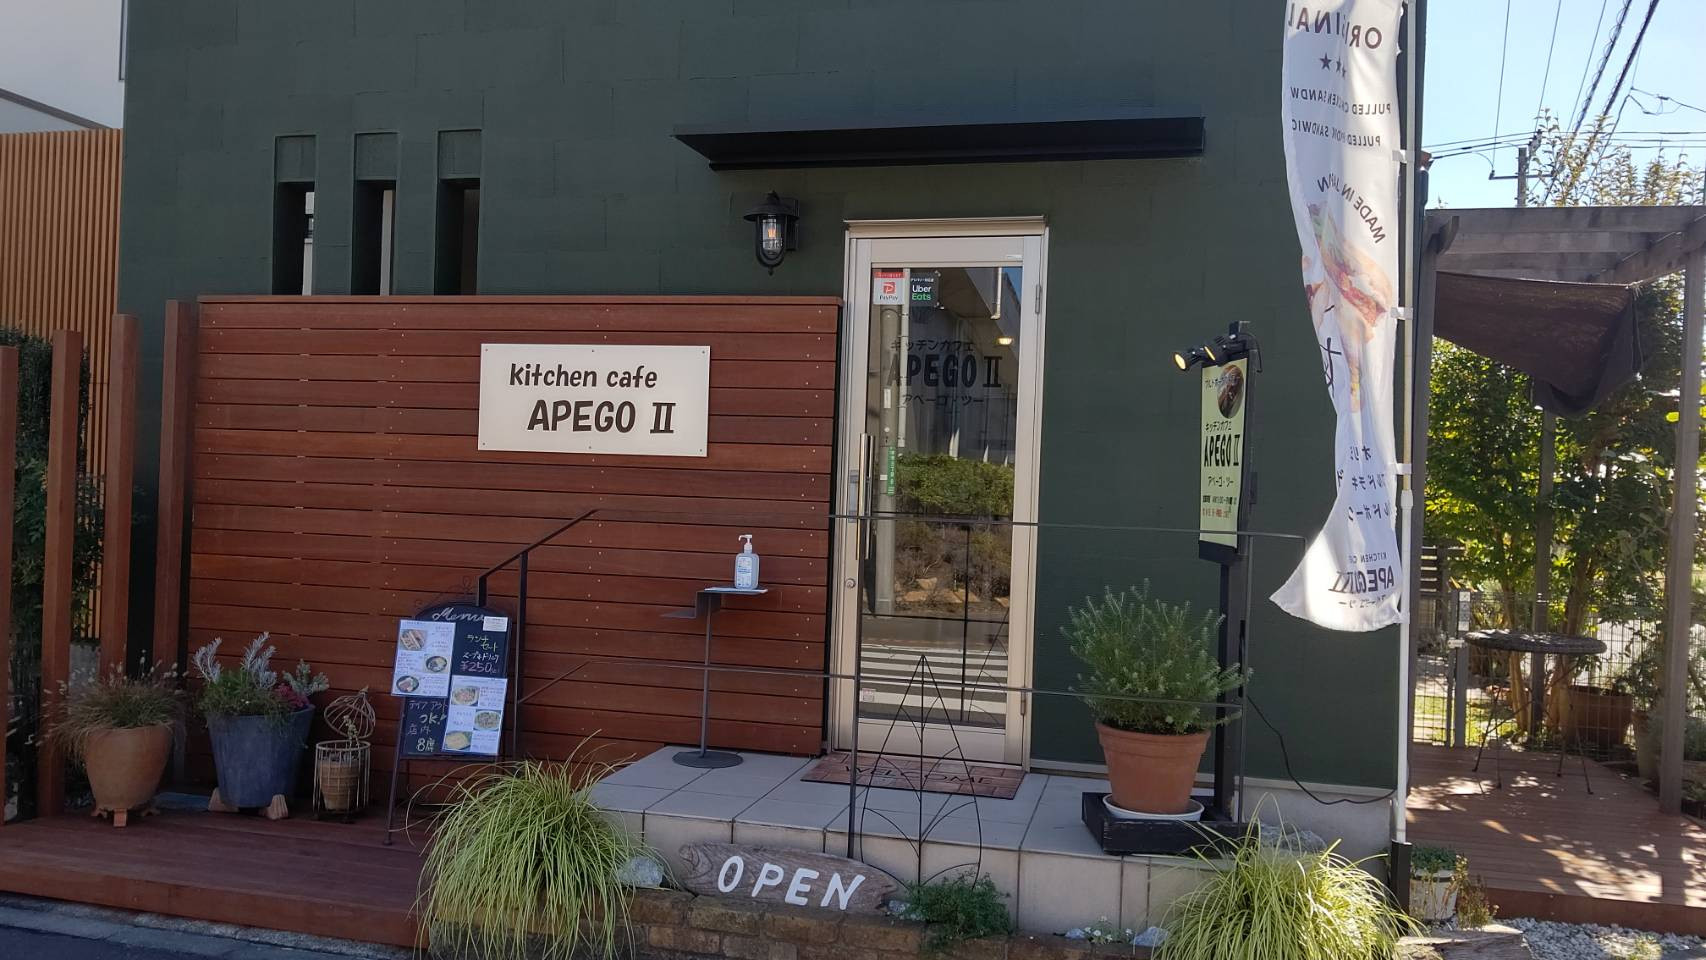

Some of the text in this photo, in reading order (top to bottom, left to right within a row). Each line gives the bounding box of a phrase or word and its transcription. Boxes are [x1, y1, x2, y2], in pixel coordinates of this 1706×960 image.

[911, 293, 932, 301] Eats
[912, 285, 932, 293] Uber
[509, 363, 658, 389] kitchen cafe
[886, 353, 978, 388] APEGO
[527, 399, 636, 434] APEGO
[1204, 433, 1232, 467] APEGO
[845, 764, 994, 785] WELCOME
[717, 856, 866, 911] OPEN
